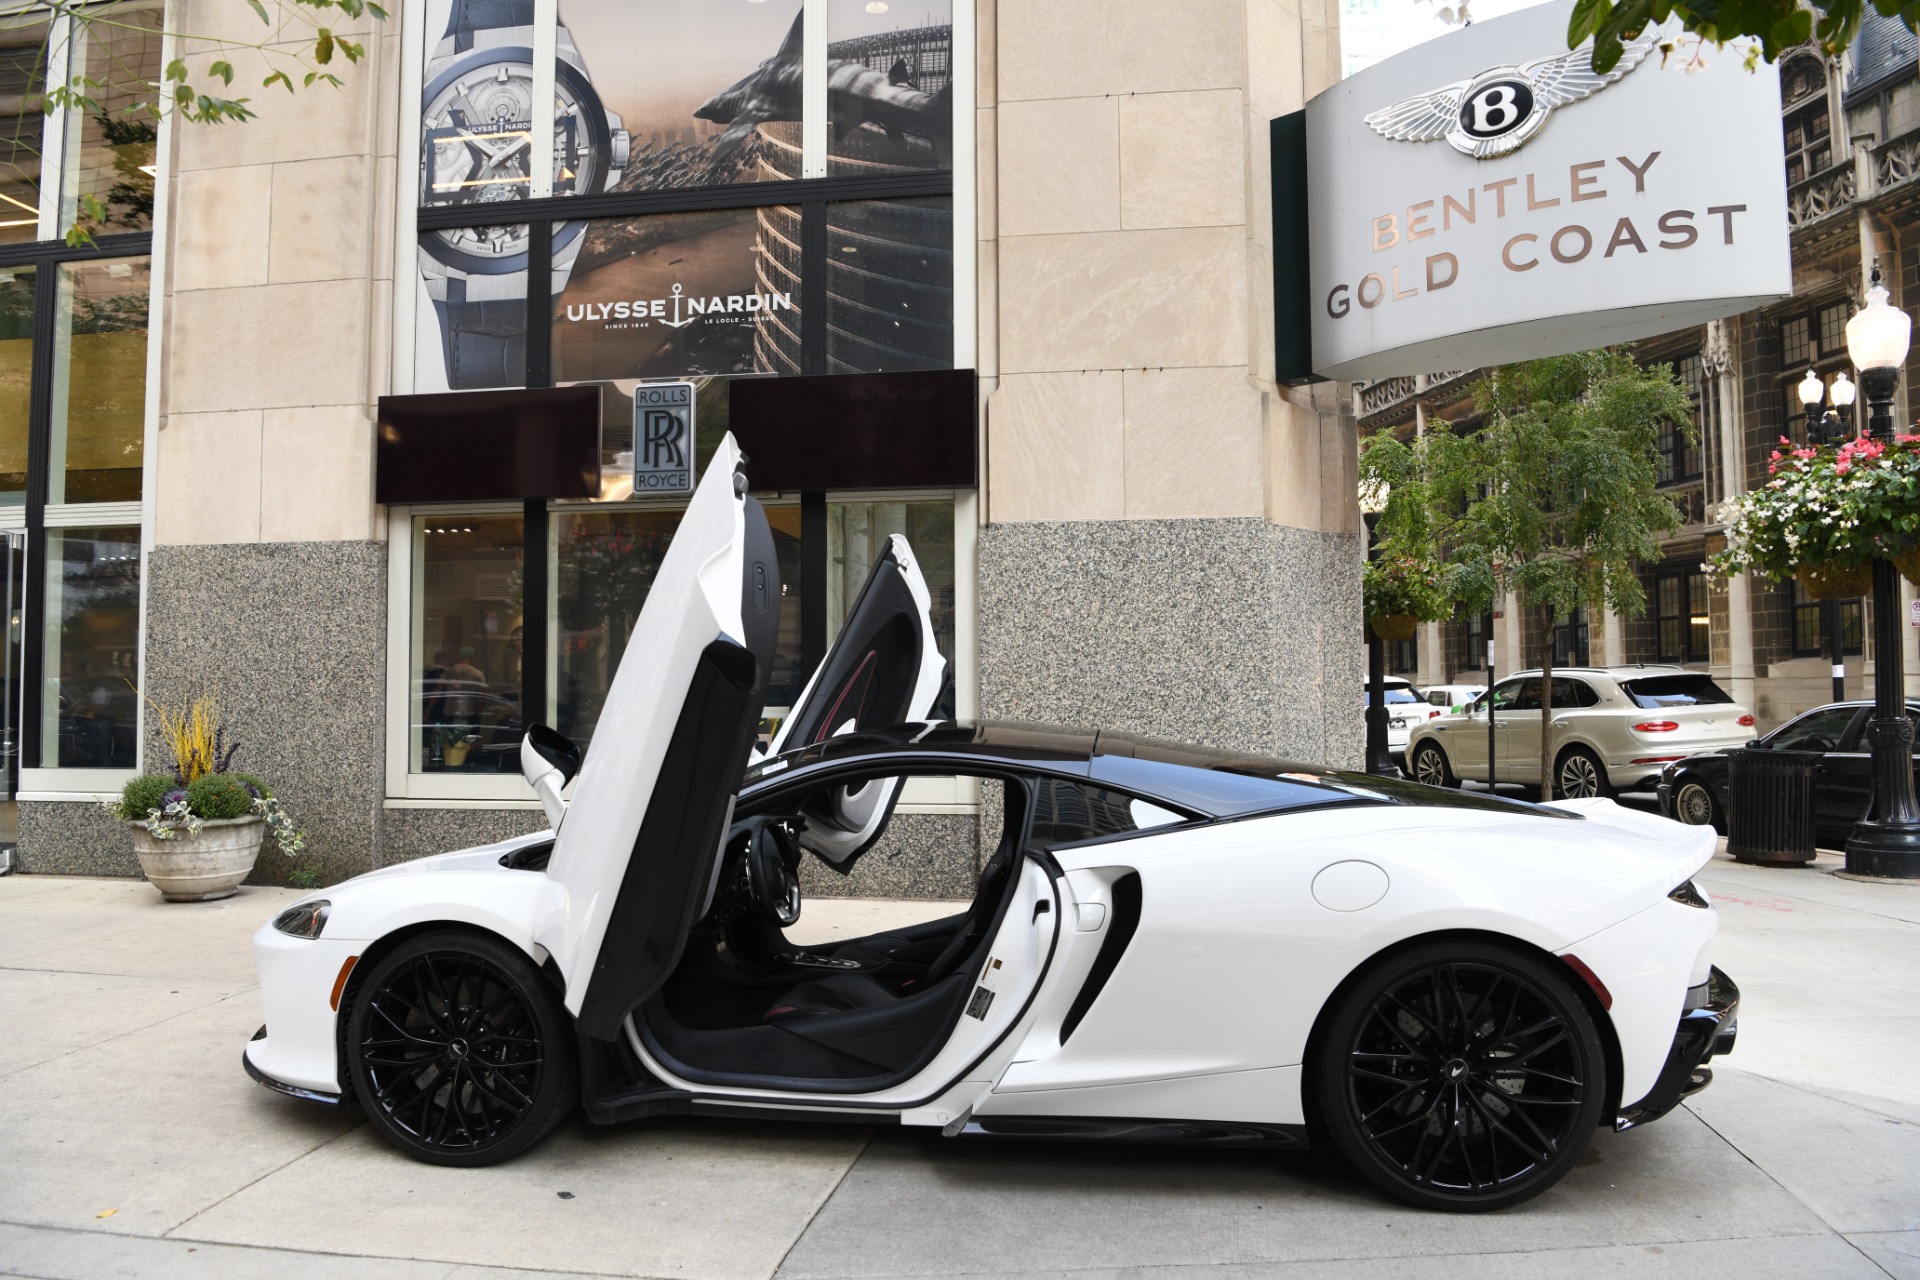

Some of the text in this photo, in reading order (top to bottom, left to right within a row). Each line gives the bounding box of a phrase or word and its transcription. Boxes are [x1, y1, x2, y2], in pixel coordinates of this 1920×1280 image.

[1472, 85, 1519, 132] B
[468, 122, 531, 133] ULYSSE NARDI
[1372, 151, 1662, 253] BENTLEY
[1326, 204, 1747, 319] GOLD COAST
[566, 292, 791, 322] ULYSSE NARDIN
[640, 389, 687, 403] ROLLS
[638, 473, 687, 488] ROYCE
